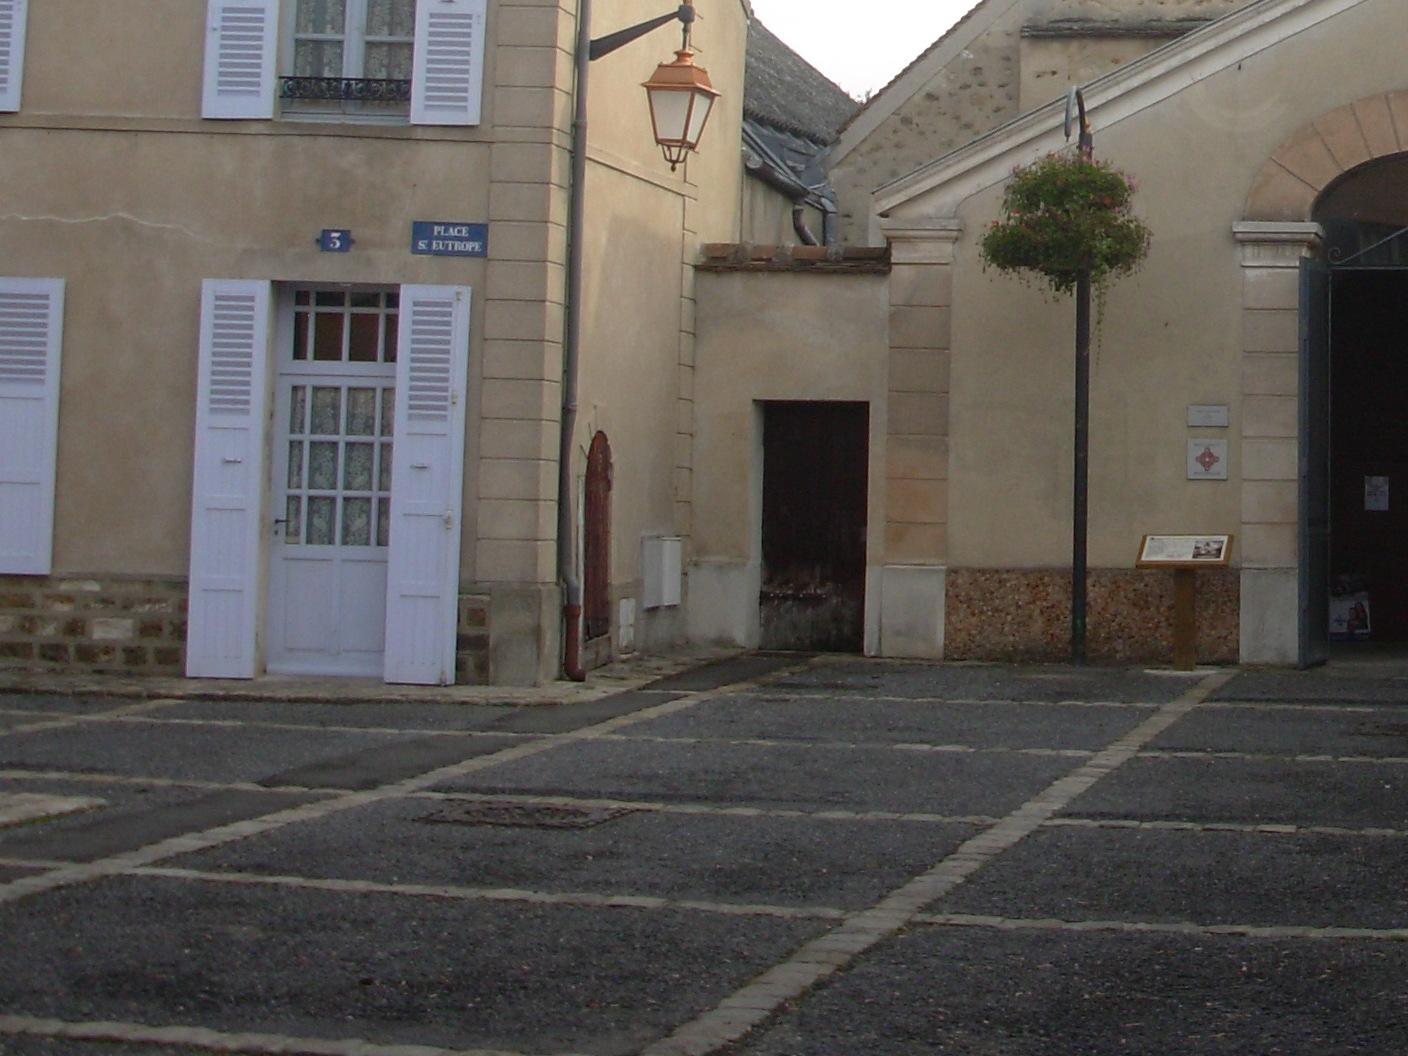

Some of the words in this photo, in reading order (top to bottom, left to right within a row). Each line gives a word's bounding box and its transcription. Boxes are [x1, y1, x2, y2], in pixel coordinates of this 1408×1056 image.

[434, 226, 469, 237] PLACE
[330, 232, 341, 248] 3
[433, 241, 482, 251] EUTROPE
